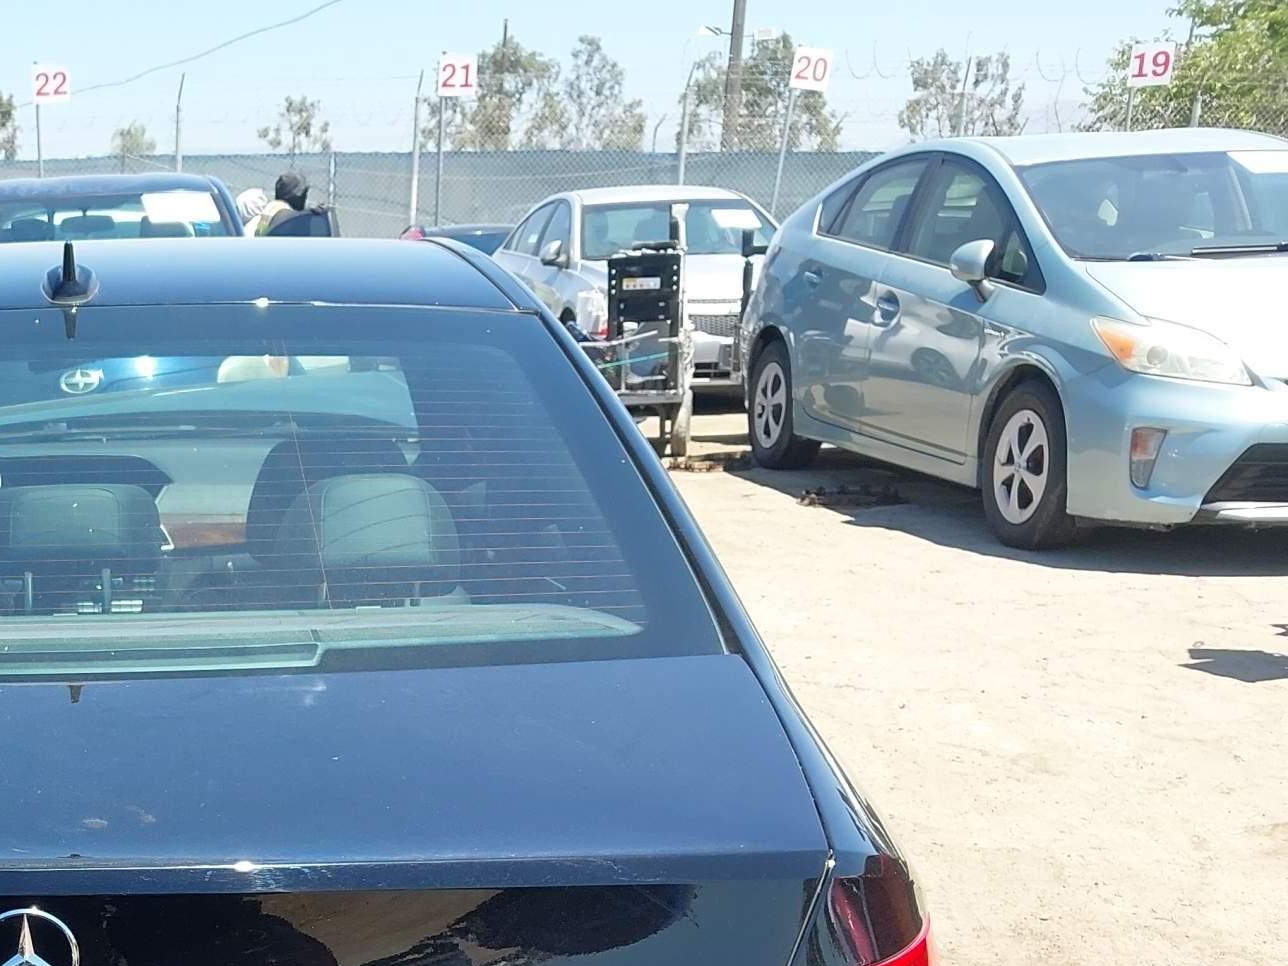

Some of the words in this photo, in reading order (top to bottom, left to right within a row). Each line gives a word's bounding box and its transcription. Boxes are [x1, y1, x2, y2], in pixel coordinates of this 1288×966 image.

[441, 63, 473, 88] 21
[795, 55, 827, 81] 20
[1132, 51, 1171, 78] 19
[35, 72, 67, 96] 22
